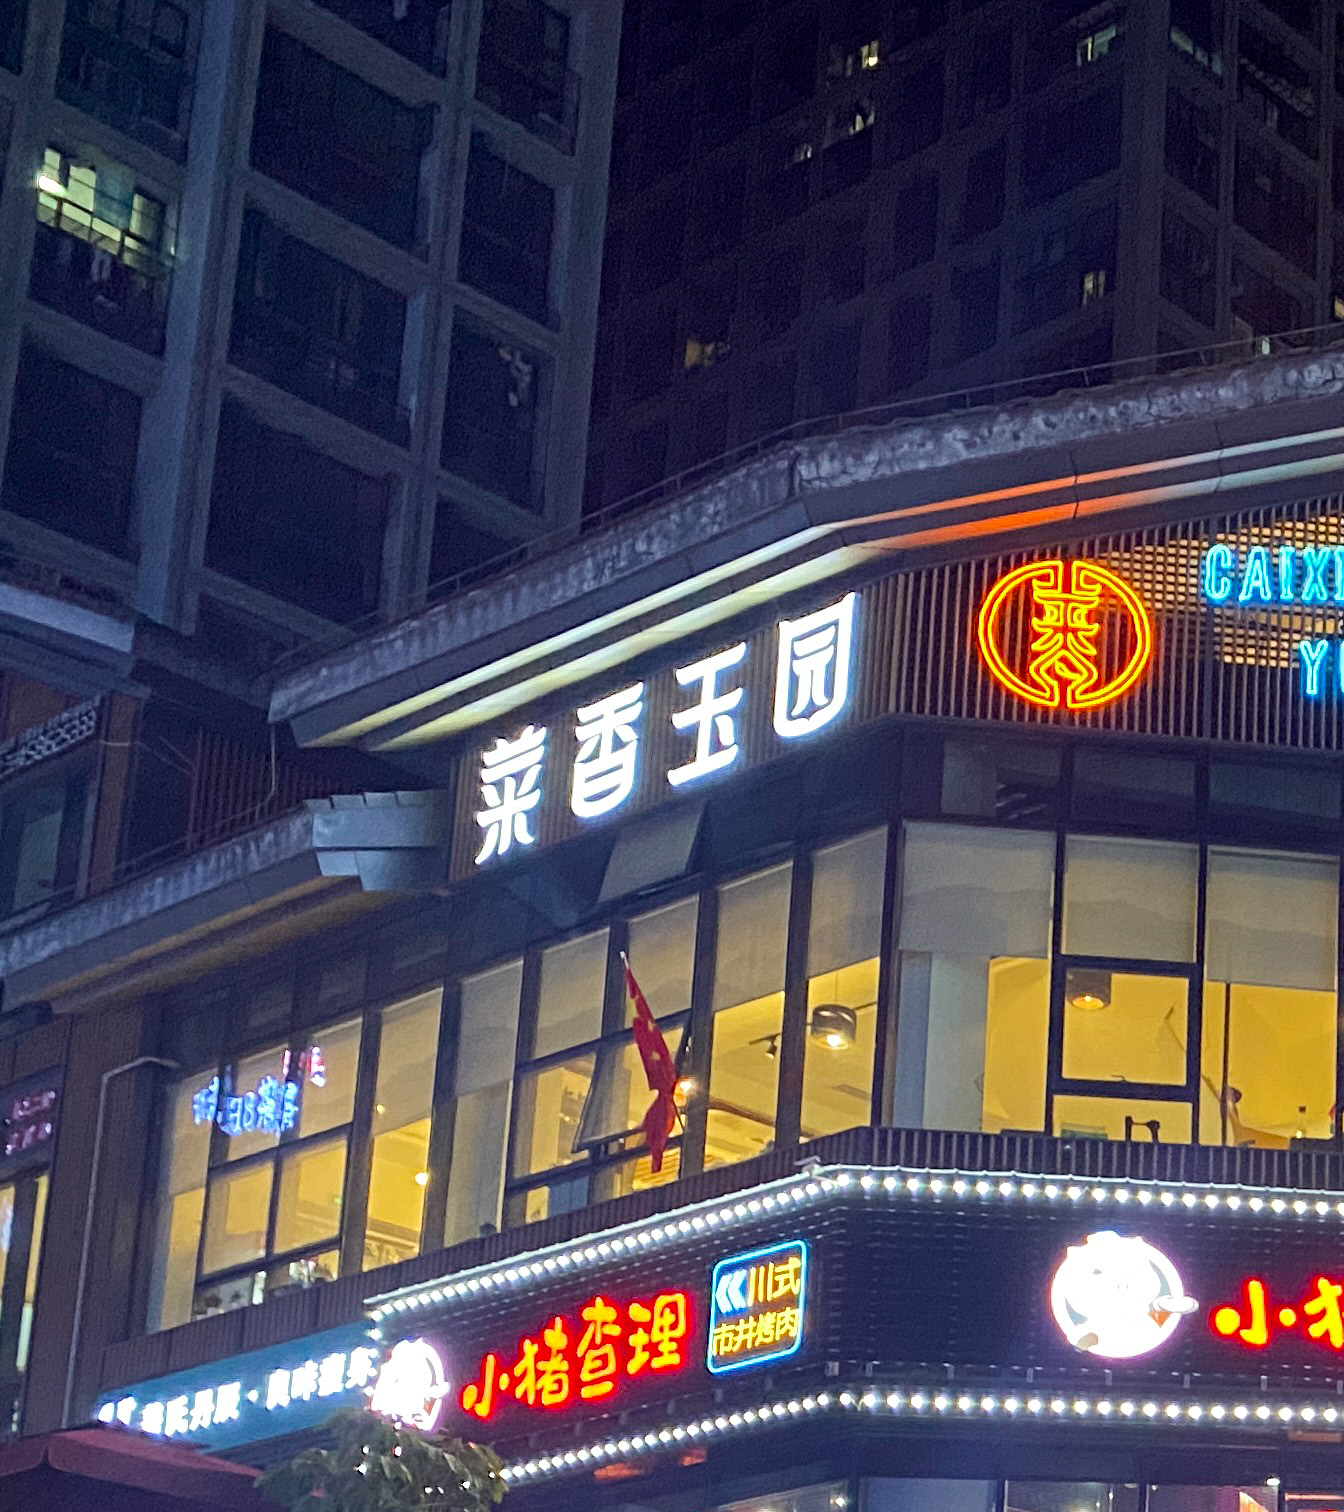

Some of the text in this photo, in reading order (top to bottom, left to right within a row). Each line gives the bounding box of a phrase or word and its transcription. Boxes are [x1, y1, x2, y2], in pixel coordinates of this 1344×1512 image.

[474, 590, 858, 866] 菜香玉园
[747, 1255, 802, 1306] 川式
[460, 1291, 690, 1422] 小猪查理
[712, 1303, 801, 1357] 市井烤肉
